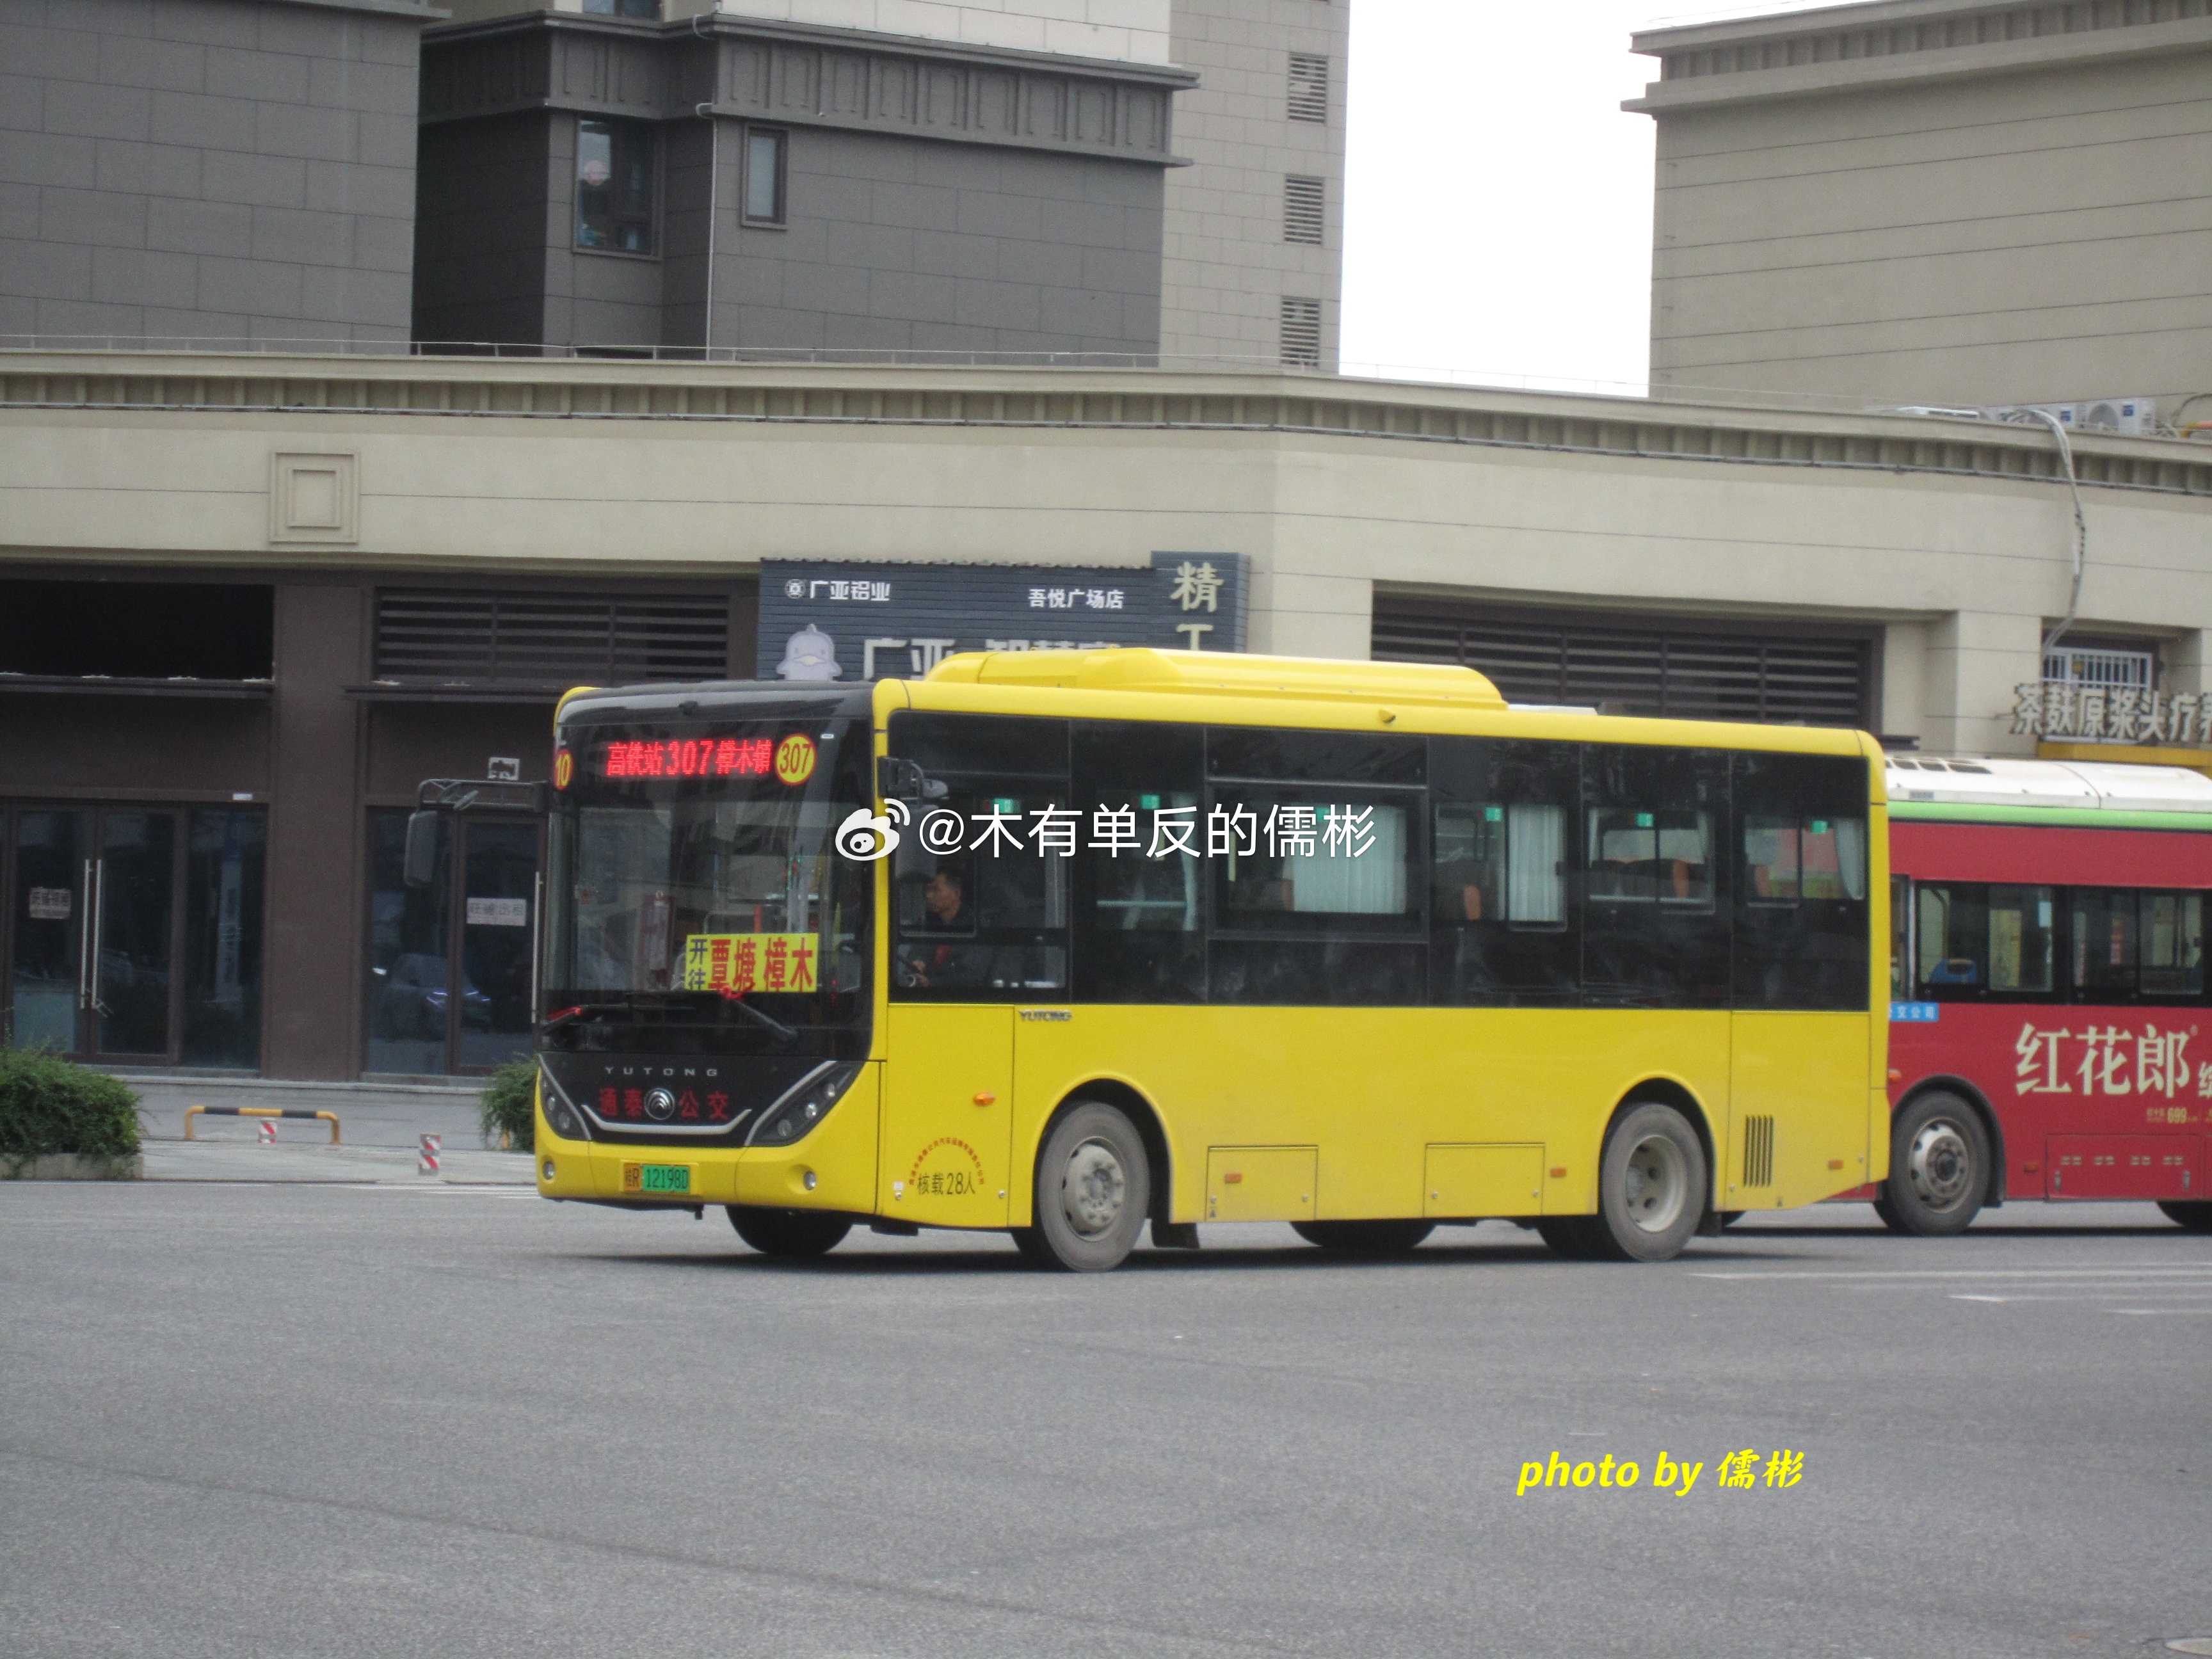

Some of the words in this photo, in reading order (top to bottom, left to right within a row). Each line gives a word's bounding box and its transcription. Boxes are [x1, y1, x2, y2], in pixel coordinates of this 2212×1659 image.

[809, 580, 891, 602] 广亚铝业
[1029, 588, 1125, 609] 吾悦广场店
[779, 742, 813, 774] 307
[689, 939, 708, 990] 开往
[1889, 1006, 1934, 1019] 交公司
[605, 1066, 717, 1077] YUTONG
[2016, 1022, 2190, 1099] 红花郎
[679, 1089, 729, 1120] 公交
[917, 1171, 976, 1196] 核载28人
